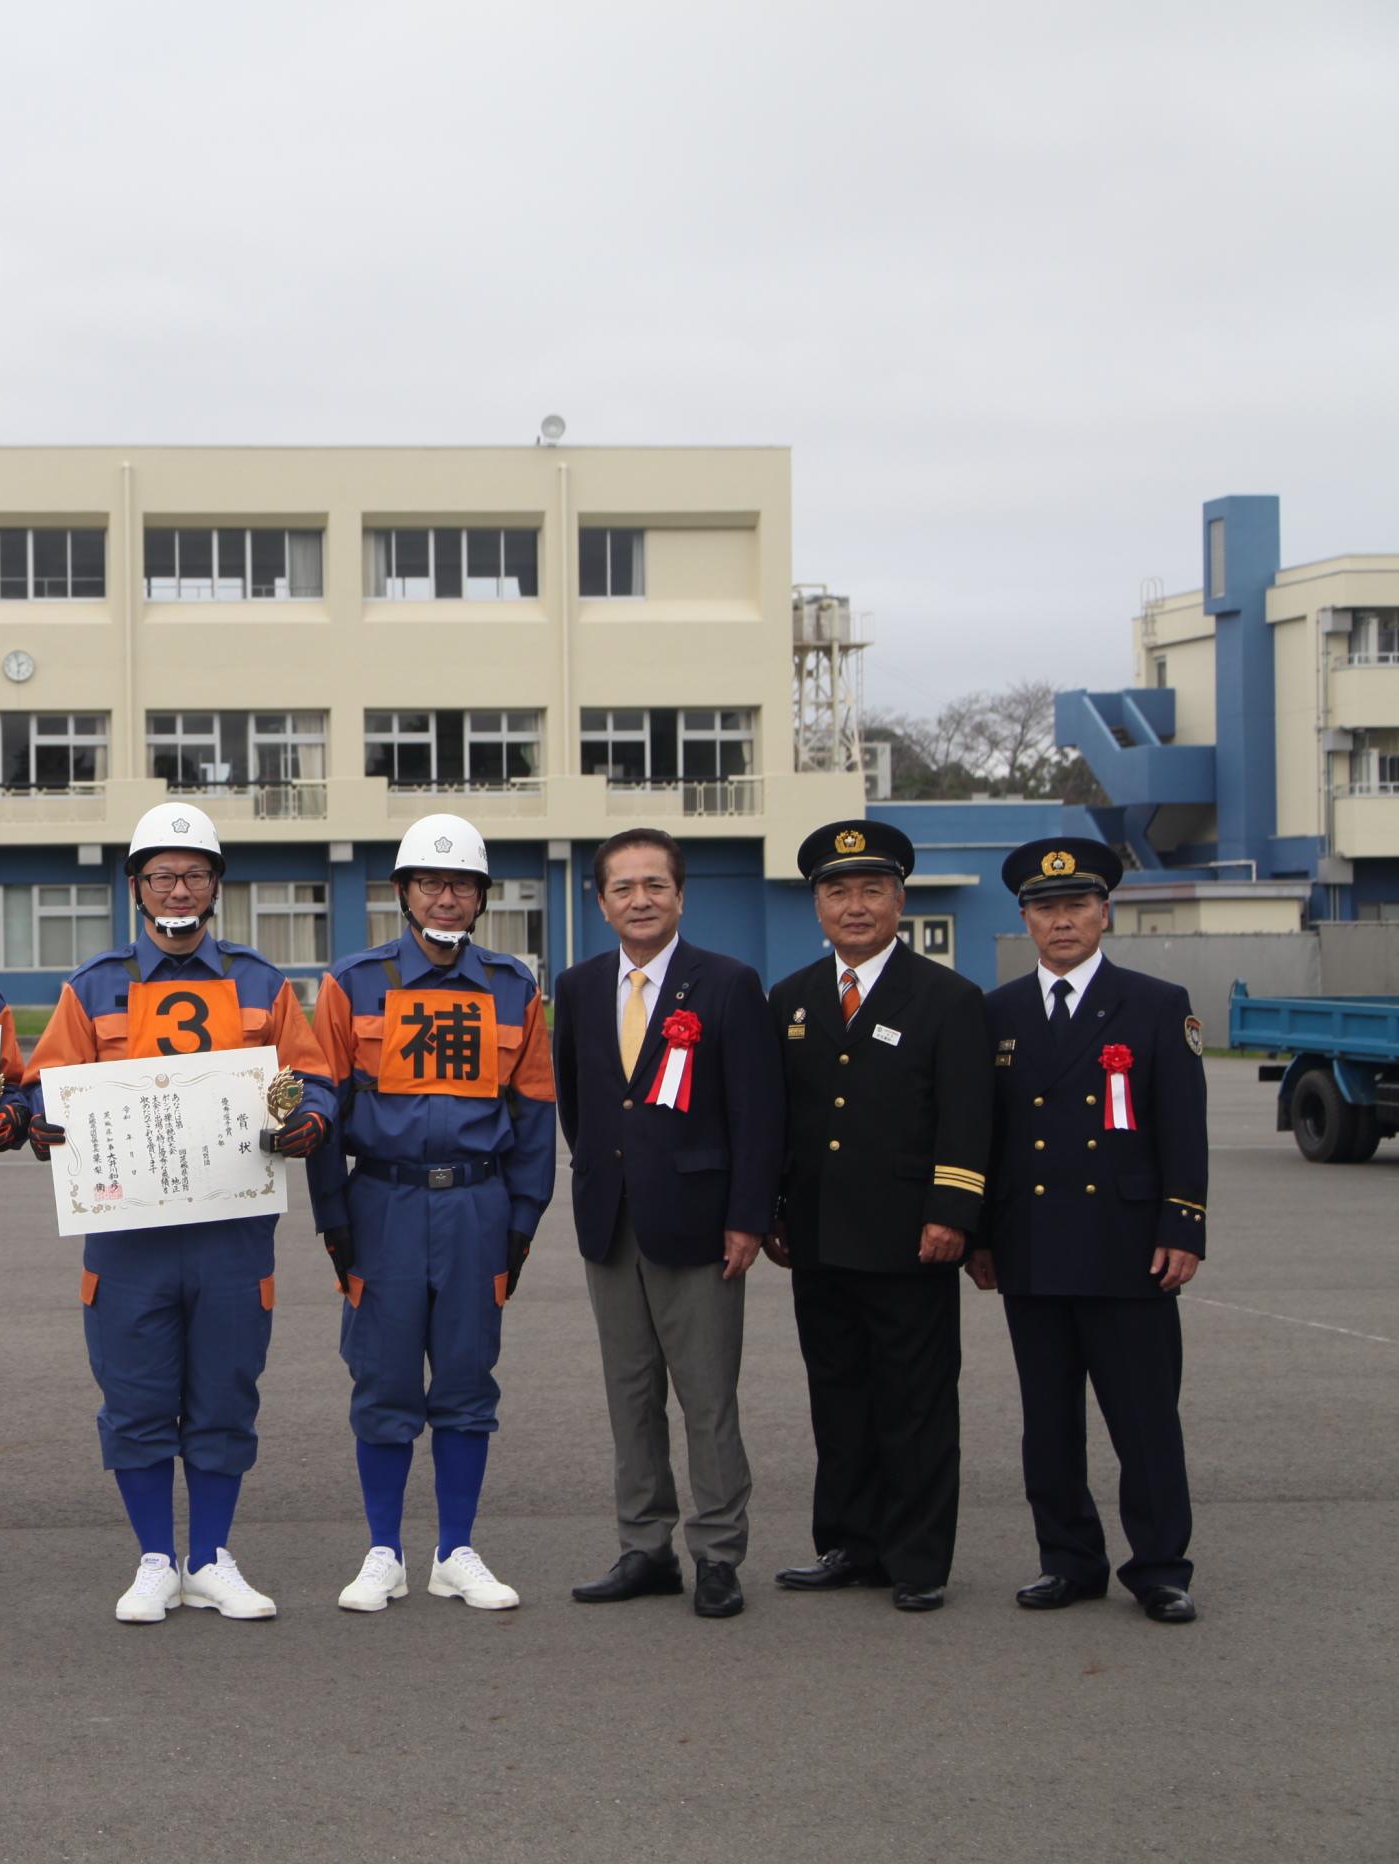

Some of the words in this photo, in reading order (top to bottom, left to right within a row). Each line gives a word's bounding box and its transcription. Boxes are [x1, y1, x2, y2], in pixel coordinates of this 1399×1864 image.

[155, 991, 213, 1056] 3
[400, 1002, 481, 1081] 補
[237, 1113, 252, 1154] 賞状
